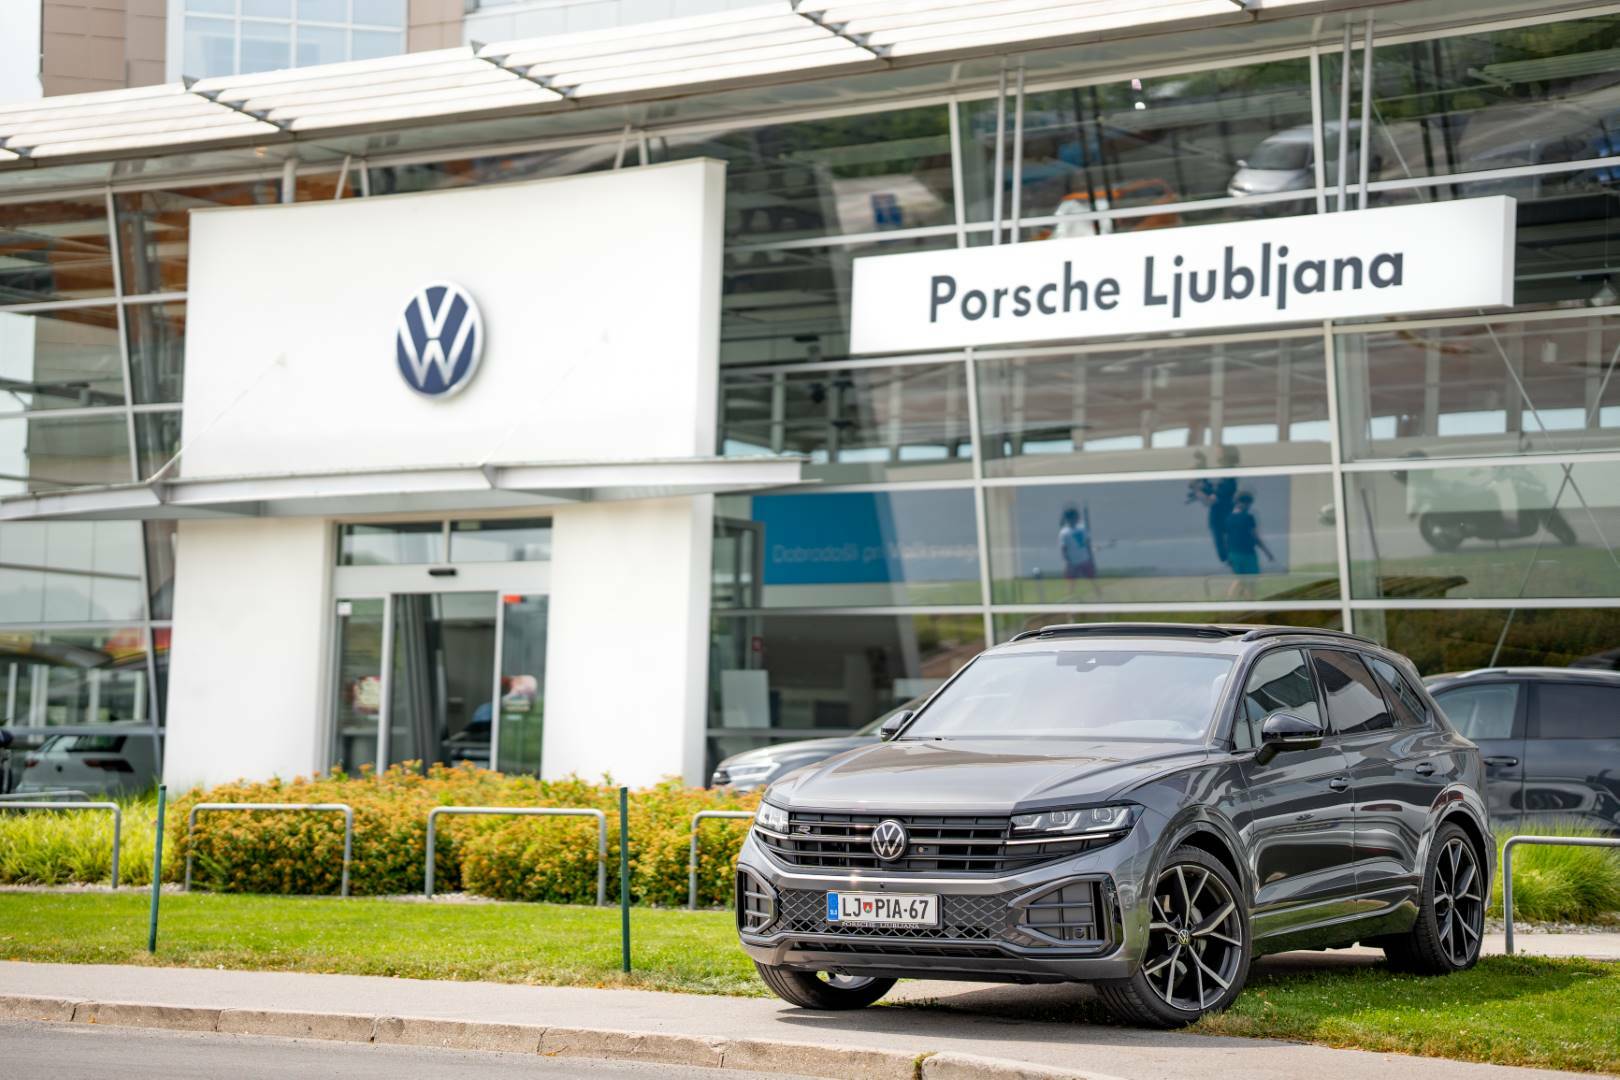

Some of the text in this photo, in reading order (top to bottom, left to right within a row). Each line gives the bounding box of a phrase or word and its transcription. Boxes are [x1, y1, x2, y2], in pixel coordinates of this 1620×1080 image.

[929, 242, 1404, 323] Porsche Ljubljana
[396, 282, 480, 394] VW
[872, 821, 906, 859] VW
[842, 897, 929, 919] LJ PIA-67
